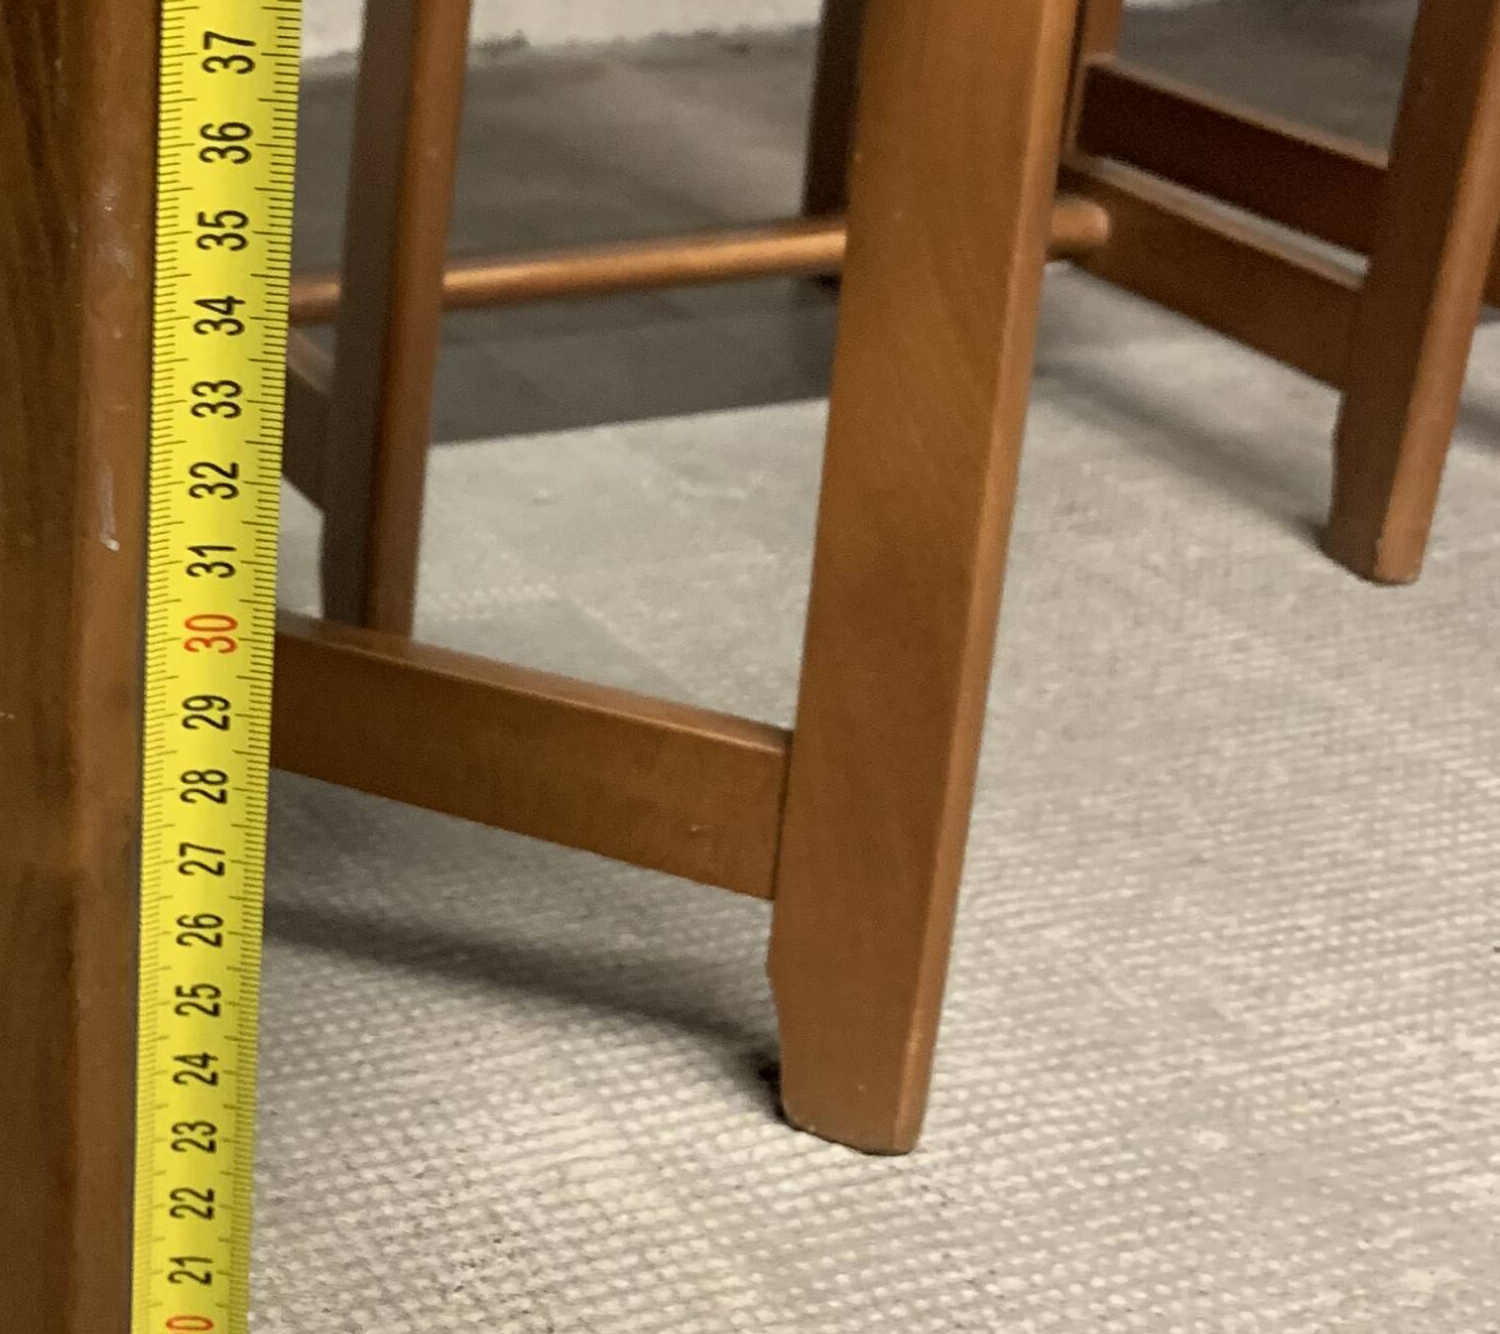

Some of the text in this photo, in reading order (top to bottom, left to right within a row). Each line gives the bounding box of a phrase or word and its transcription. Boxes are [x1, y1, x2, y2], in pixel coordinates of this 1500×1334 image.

[201, 30, 257, 75] 37
[198, 121, 254, 165] 36
[195, 209, 250, 252] 35
[193, 295, 247, 337] 34
[190, 379, 243, 420] 33
[188, 461, 240, 500] 32
[185, 545, 238, 579] 31
[183, 613, 239, 654] 30
[181, 694, 232, 732] 29
[179, 768, 229, 805] 28
[177, 842, 226, 878] 27
[175, 913, 225, 949] 26
[174, 983, 222, 1018] 25
[172, 1051, 220, 1087] 24
[170, 1120, 218, 1154] 23
[169, 1187, 216, 1221] 22
[167, 1256, 214, 1286] 21
